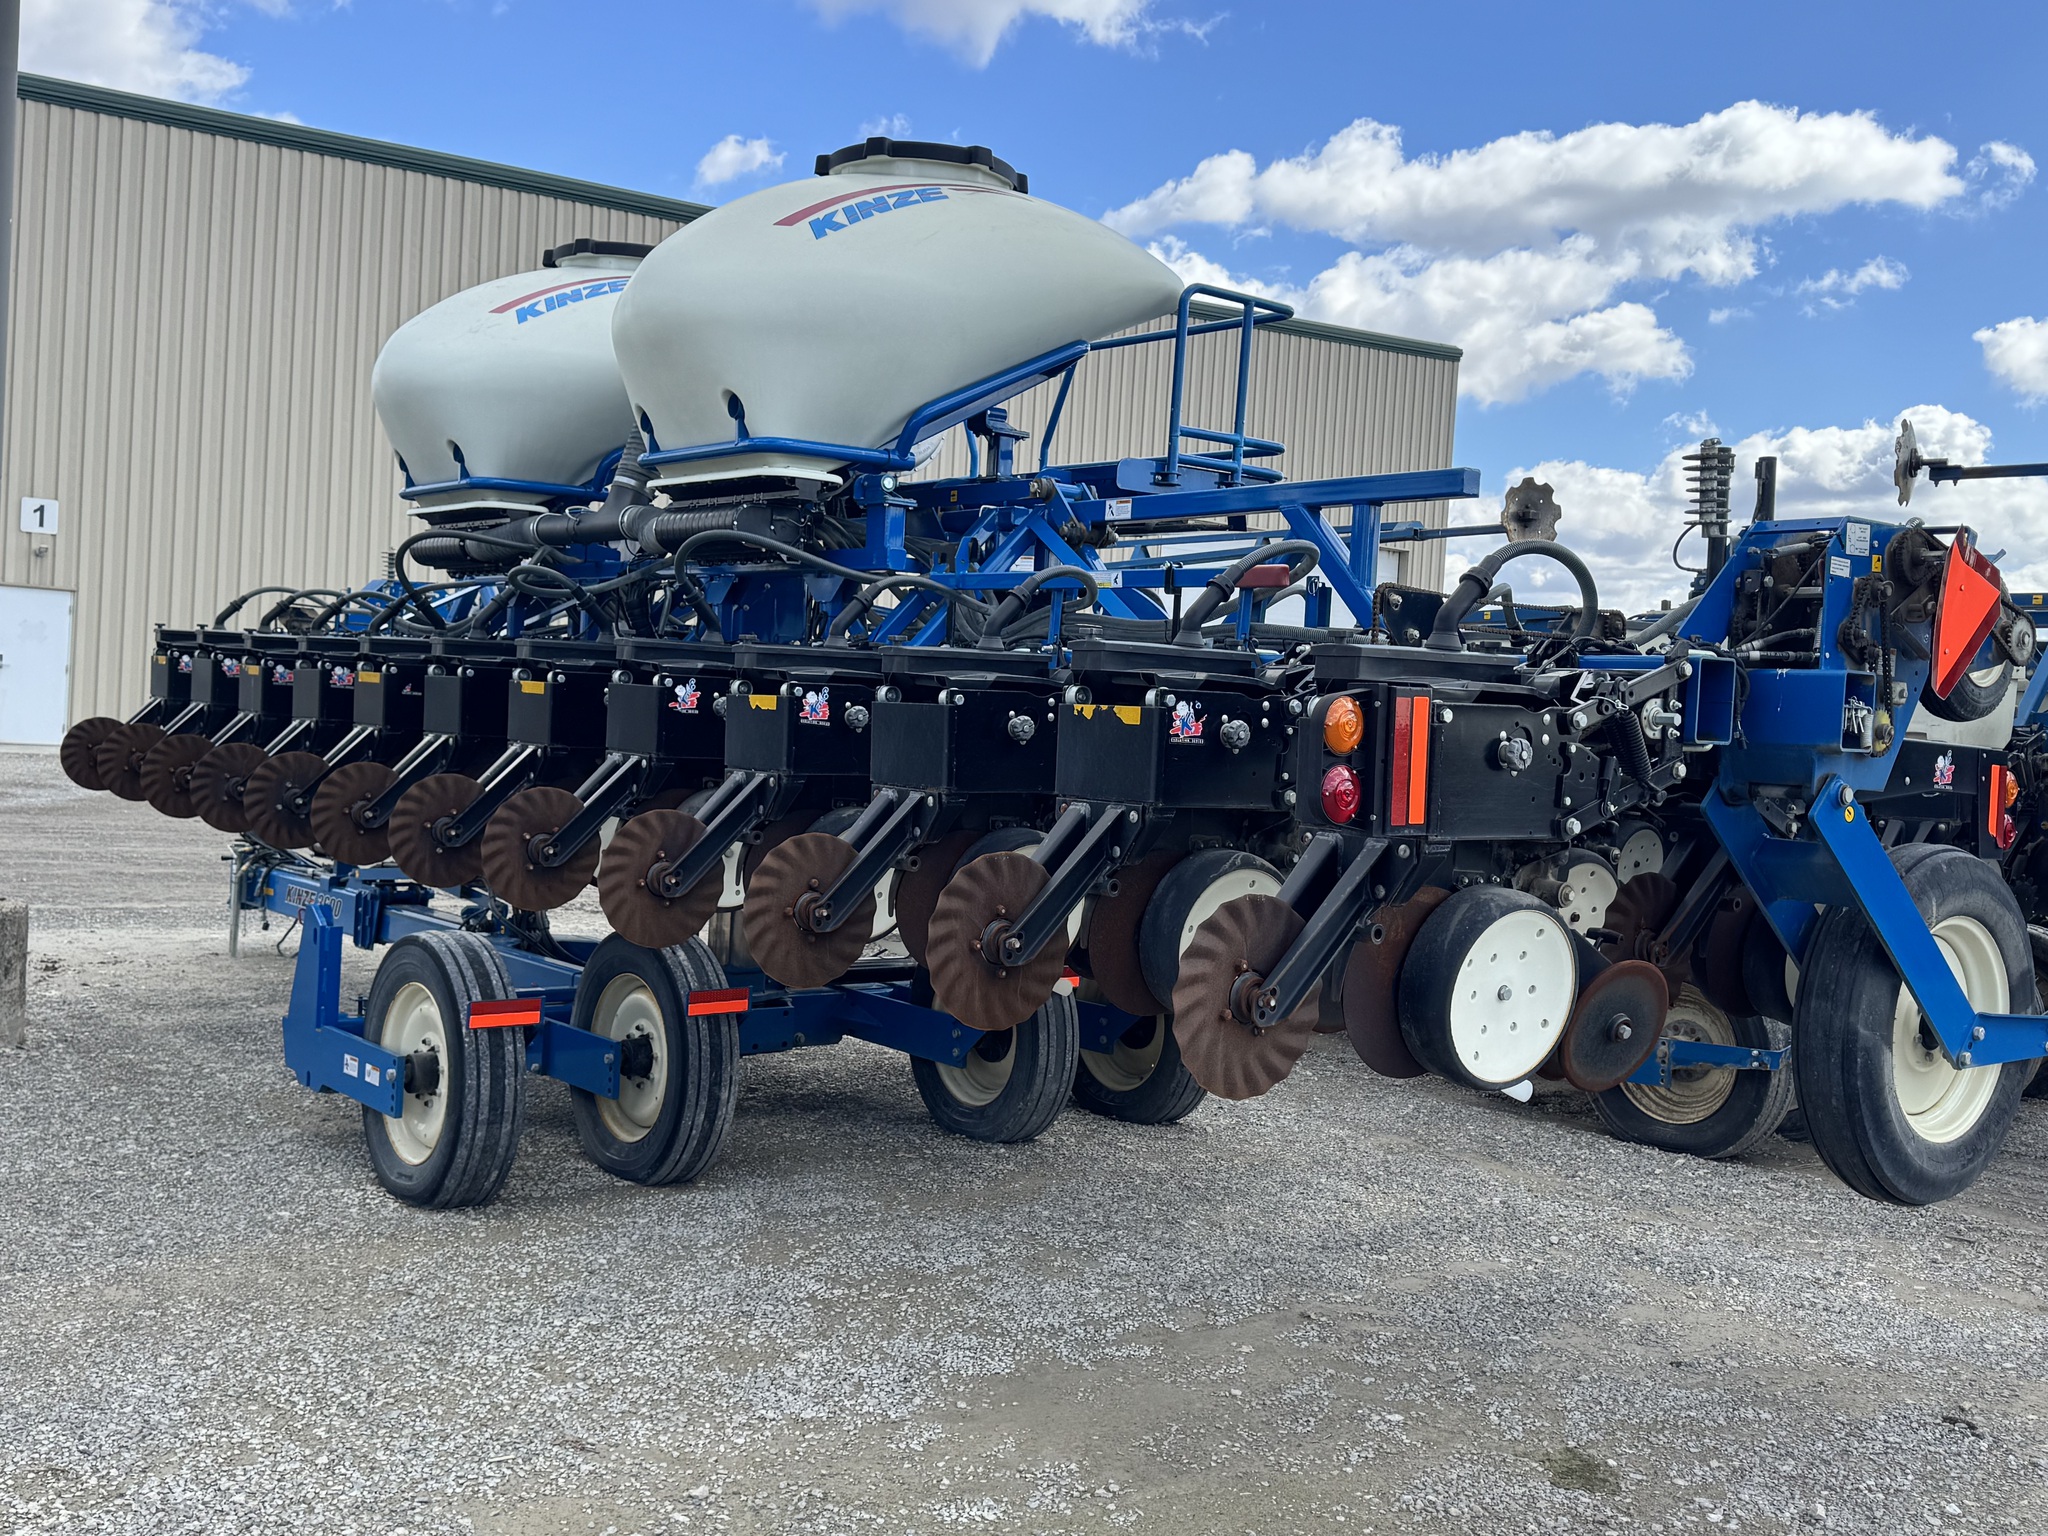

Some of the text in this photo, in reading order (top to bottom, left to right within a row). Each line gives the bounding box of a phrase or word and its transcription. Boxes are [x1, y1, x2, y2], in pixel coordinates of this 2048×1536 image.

[808, 187, 949, 240] KINZE
[515, 279, 630, 324] KINZE
[33, 504, 45, 528] 1
[285, 884, 317, 909] KINZE
